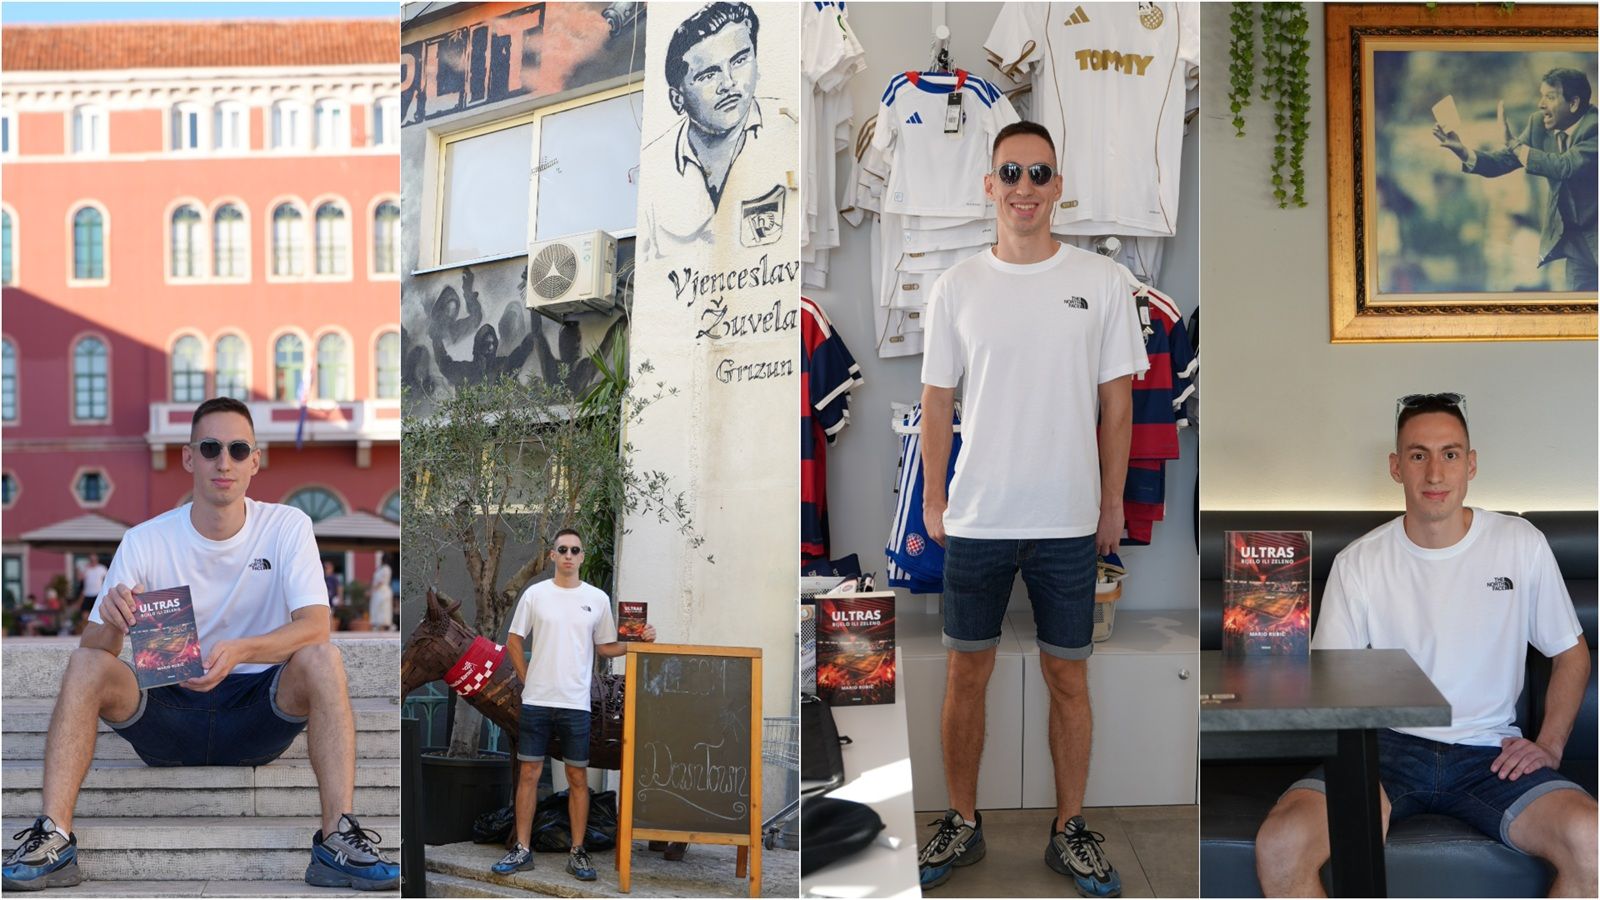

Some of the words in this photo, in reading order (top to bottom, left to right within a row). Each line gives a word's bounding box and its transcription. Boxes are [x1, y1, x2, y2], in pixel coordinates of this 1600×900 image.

[1075, 49, 1154, 76] TOMMY
[668, 254, 799, 307] Vjenceslav
[695, 296, 798, 340] Žuvela
[1241, 547, 1295, 558] ULTRAS
[139, 598, 181, 613] ULTRAS
[832, 609, 882, 621] ULTRAS
